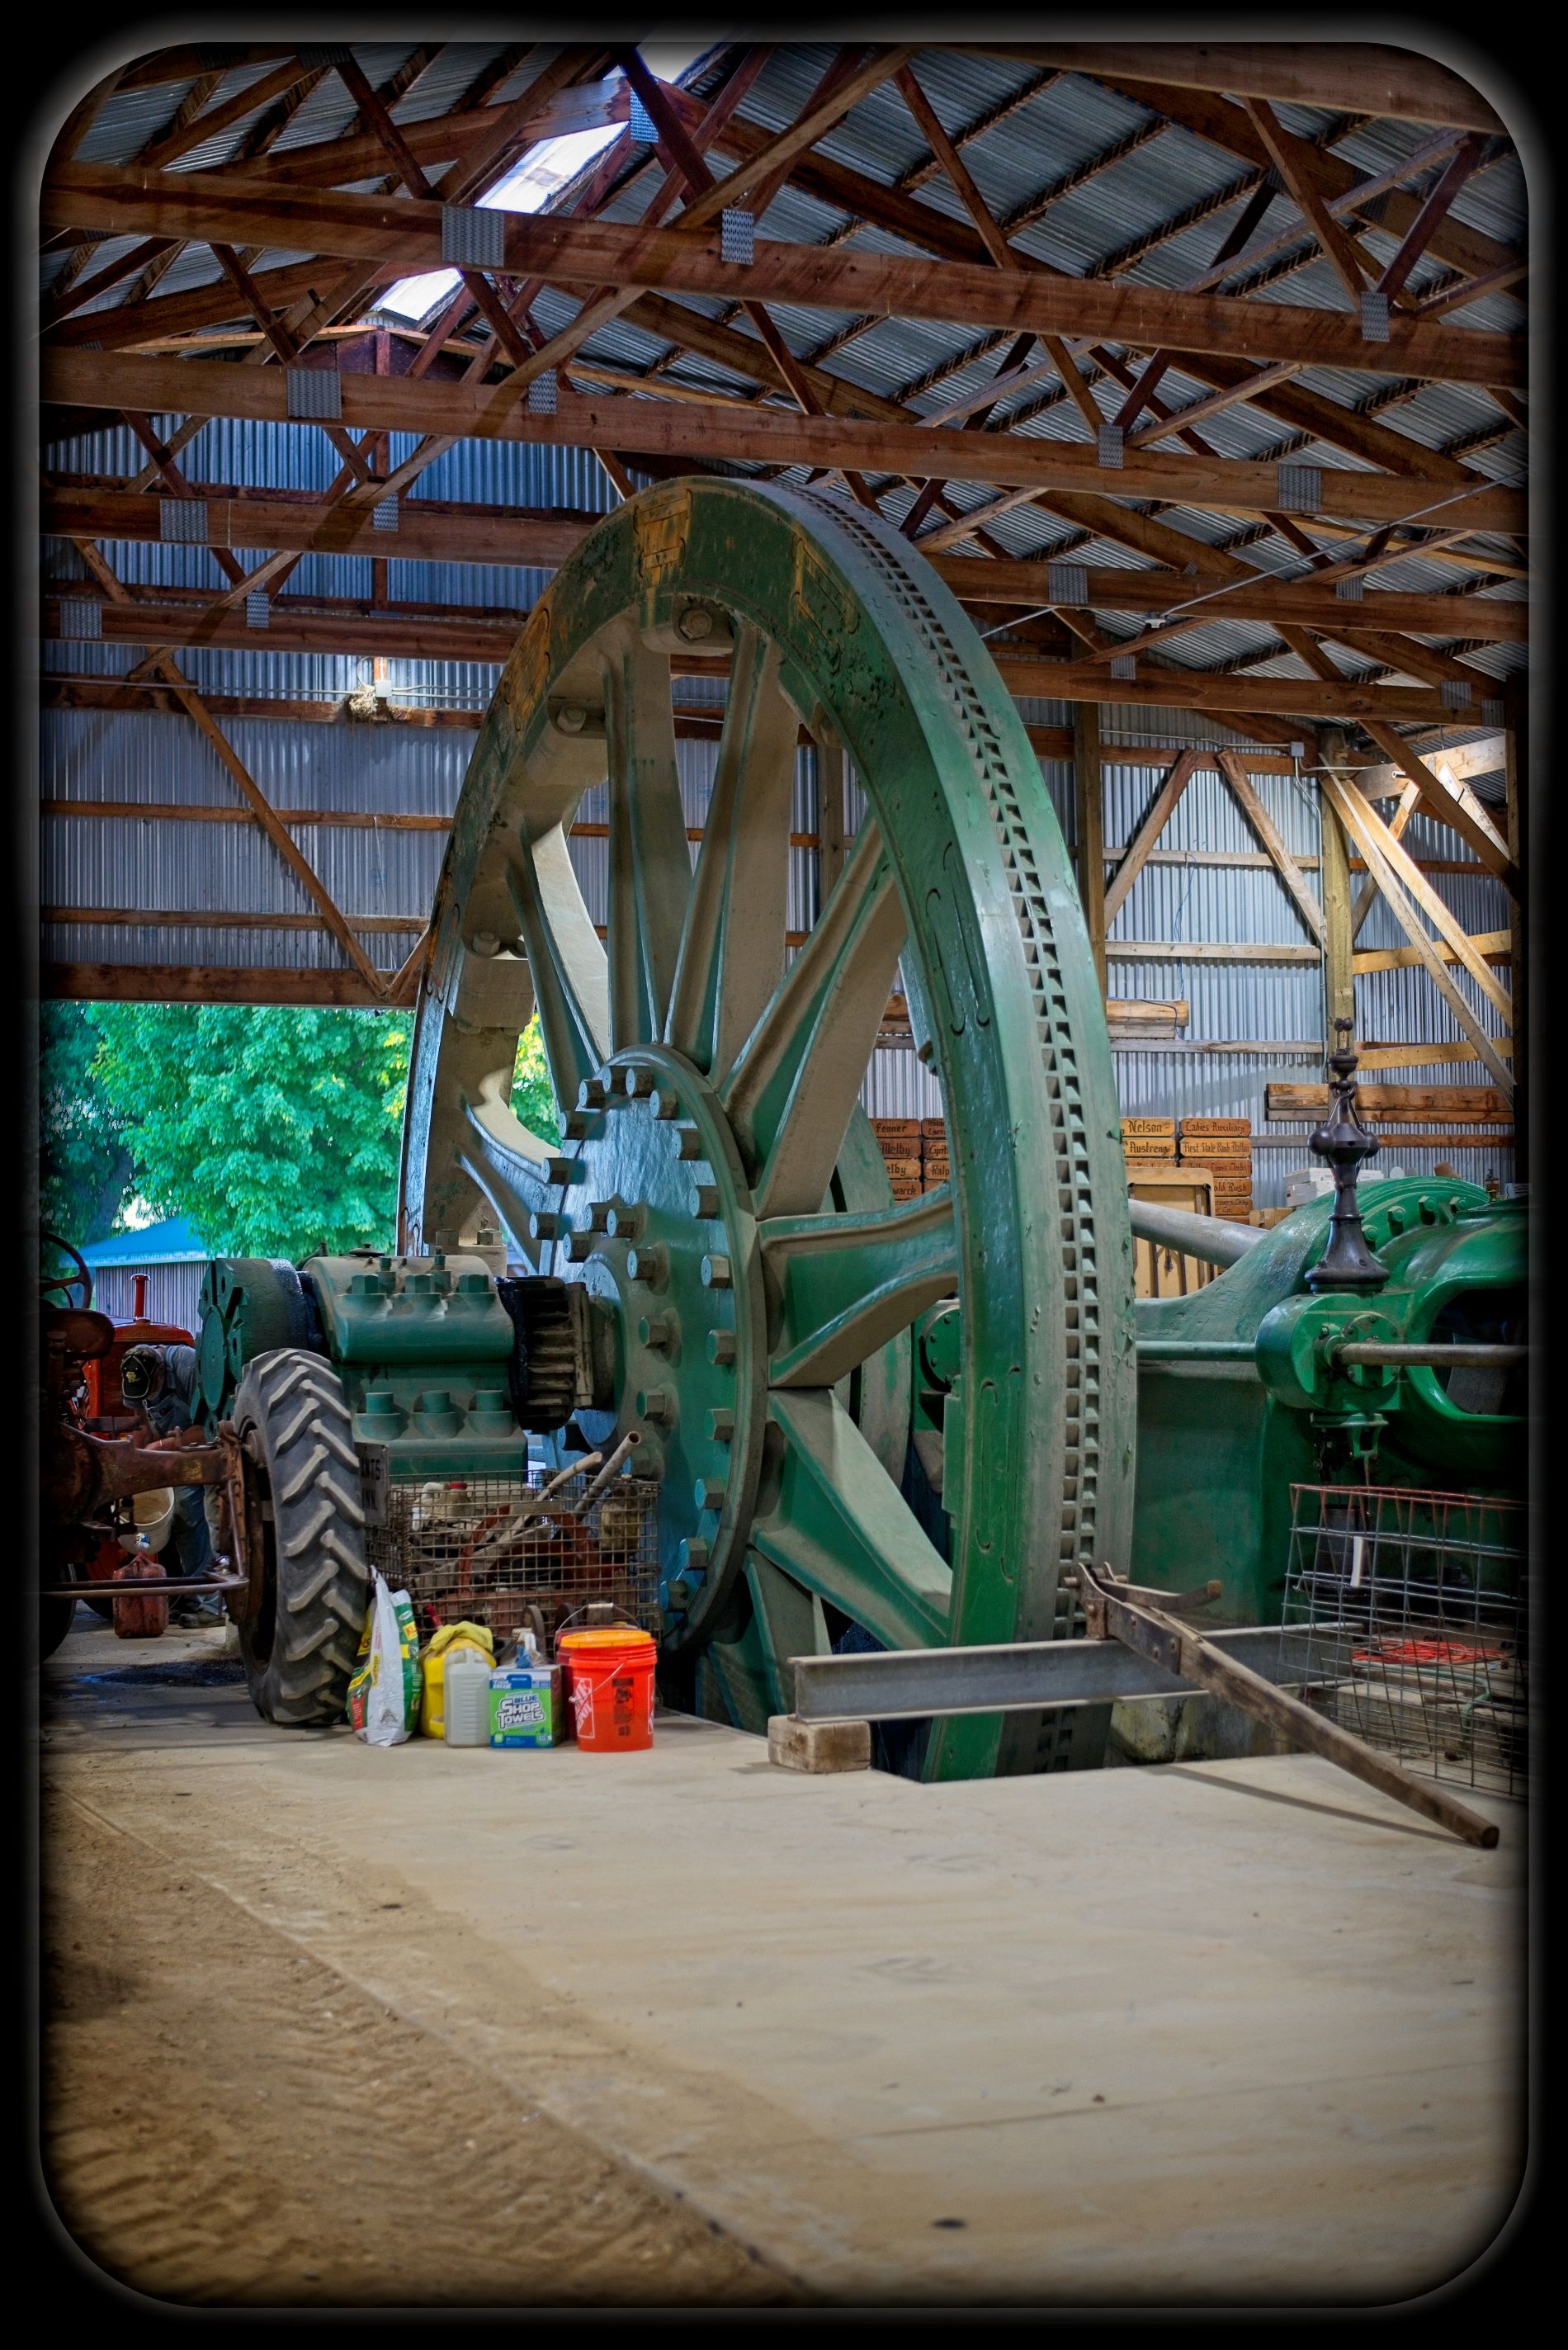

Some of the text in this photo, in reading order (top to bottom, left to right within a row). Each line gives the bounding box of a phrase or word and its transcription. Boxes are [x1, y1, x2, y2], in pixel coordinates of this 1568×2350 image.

[1128, 1120, 1163, 1132] Nelson
[1185, 1121, 1245, 1134] Ladies Auxiliary
[886, 1164, 906, 1175] elby
[514, 1695, 537, 1704] BLUE
[500, 1698, 541, 1716] SHOP
[497, 1709, 545, 1730] TOWELS
